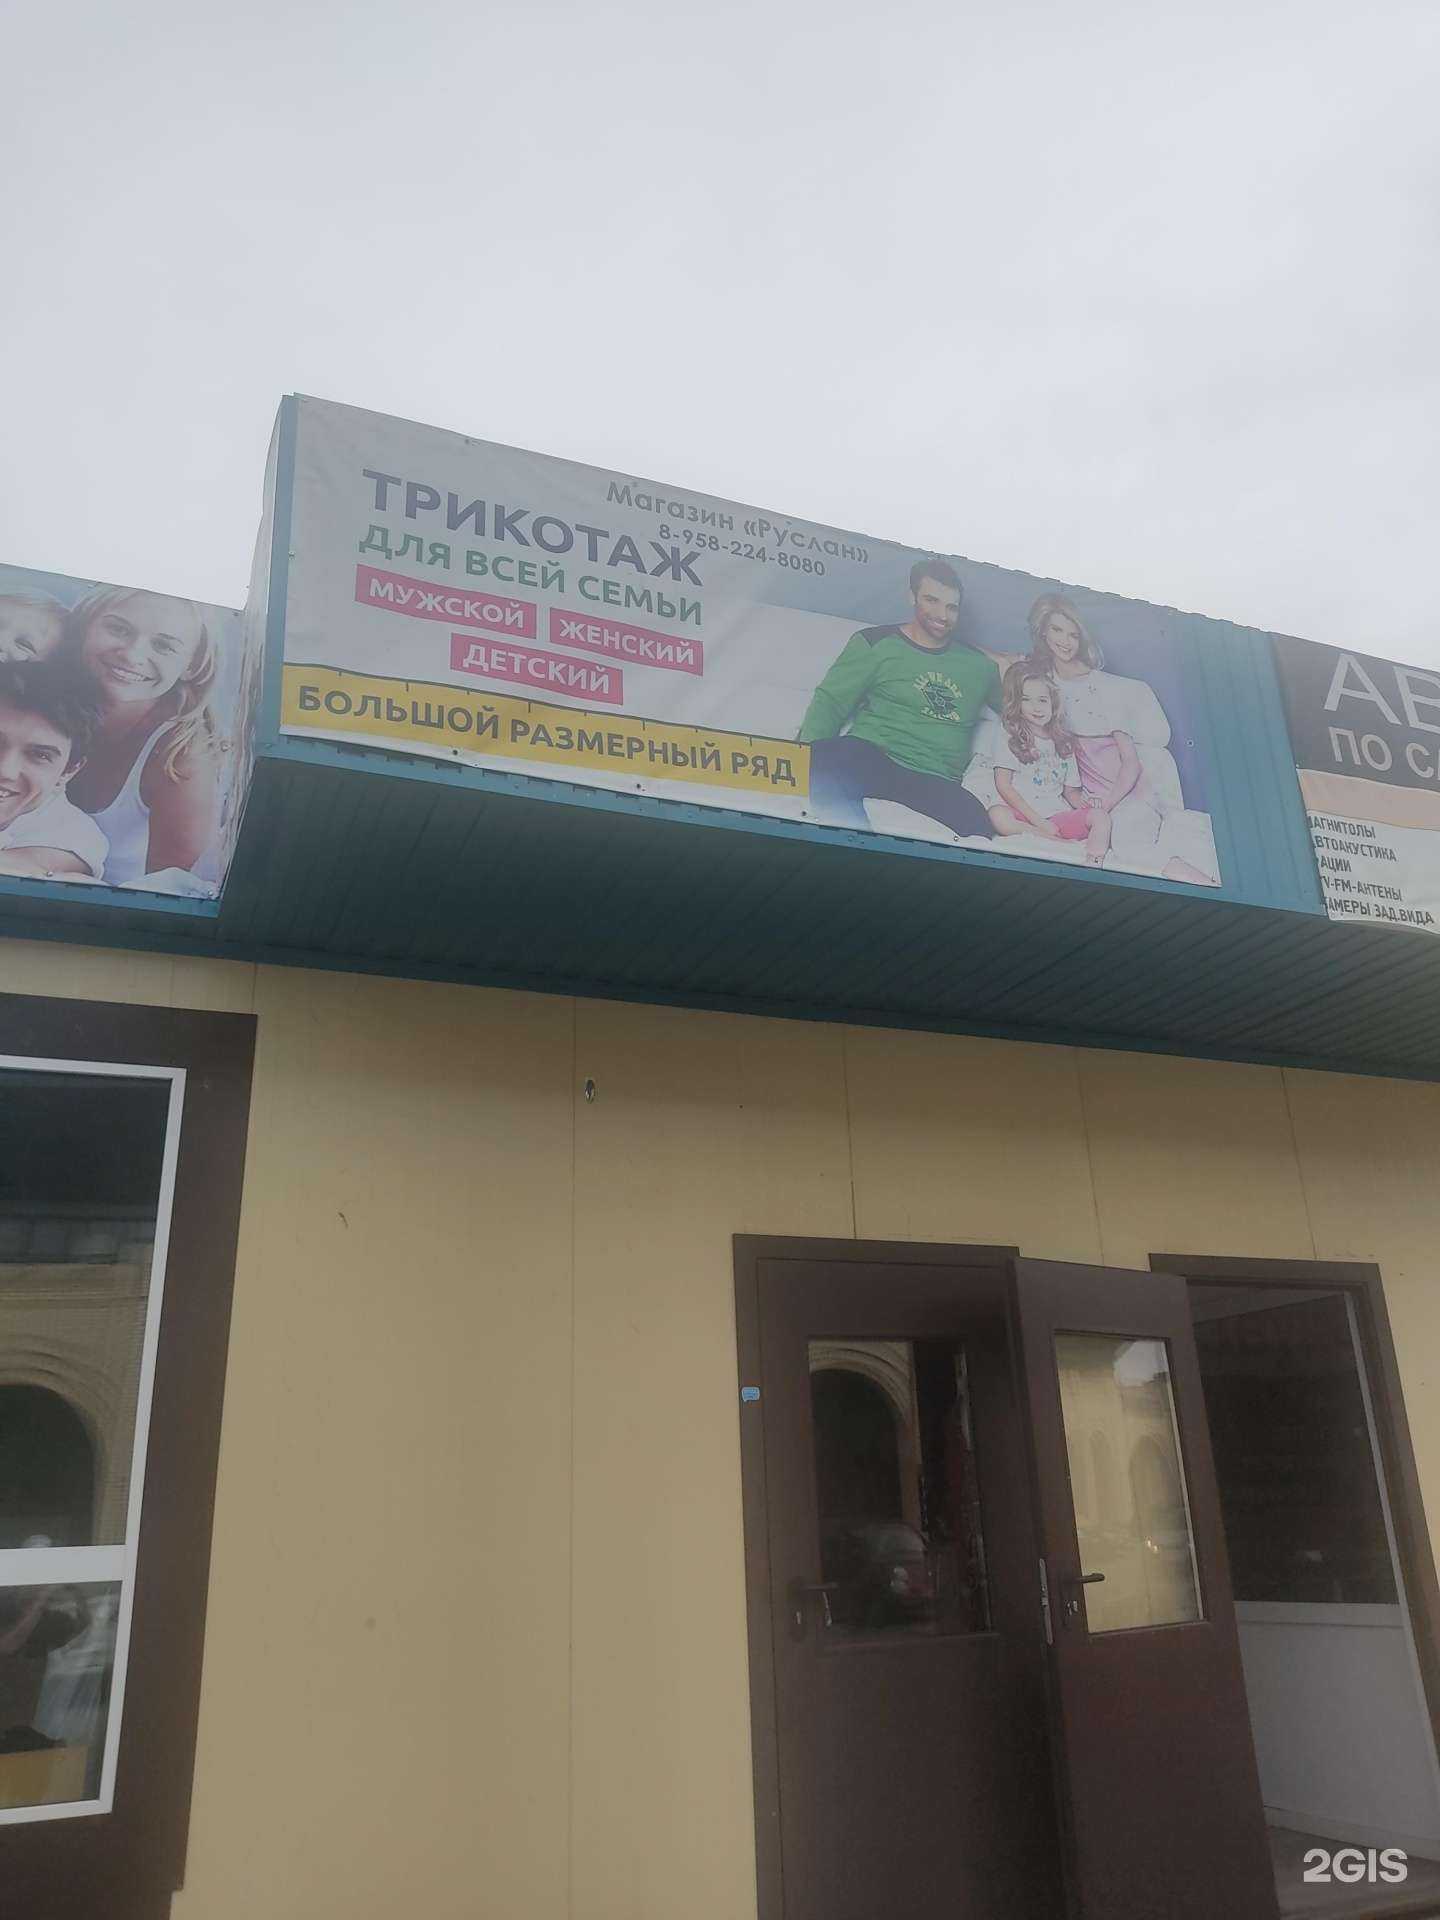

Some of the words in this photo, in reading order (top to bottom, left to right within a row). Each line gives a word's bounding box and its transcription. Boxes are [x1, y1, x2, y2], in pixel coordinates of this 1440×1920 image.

[363, 468, 703, 587] ТРИКОТАЖ
[606, 480, 734, 531] Магазин
[744, 517, 869, 564] «Руслан»
[359, 524, 452, 571] ДЛЯ
[465, 549, 566, 594] ВСЕЙ
[578, 574, 703, 627] СЕМЬИ
[659, 523, 826, 577] 8-958-224-8080
[368, 577, 526, 631] МУЖСКОЙ
[462, 643, 610, 696] ДЕТСКИЙ
[558, 618, 696, 667] ЖЕНСКИЙ
[297, 685, 500, 740] БОЛЬШОЙ
[510, 719, 723, 773] РАЗМЕРНЫЙ
[731, 754, 797, 787] РЯД
[1328, 726, 1393, 772] ПО
[1406, 742, 1440, 781] С
[1313, 834, 1397, 862] ВТОАКУСТИКА
[1319, 855, 1352, 873] АЦИИ
